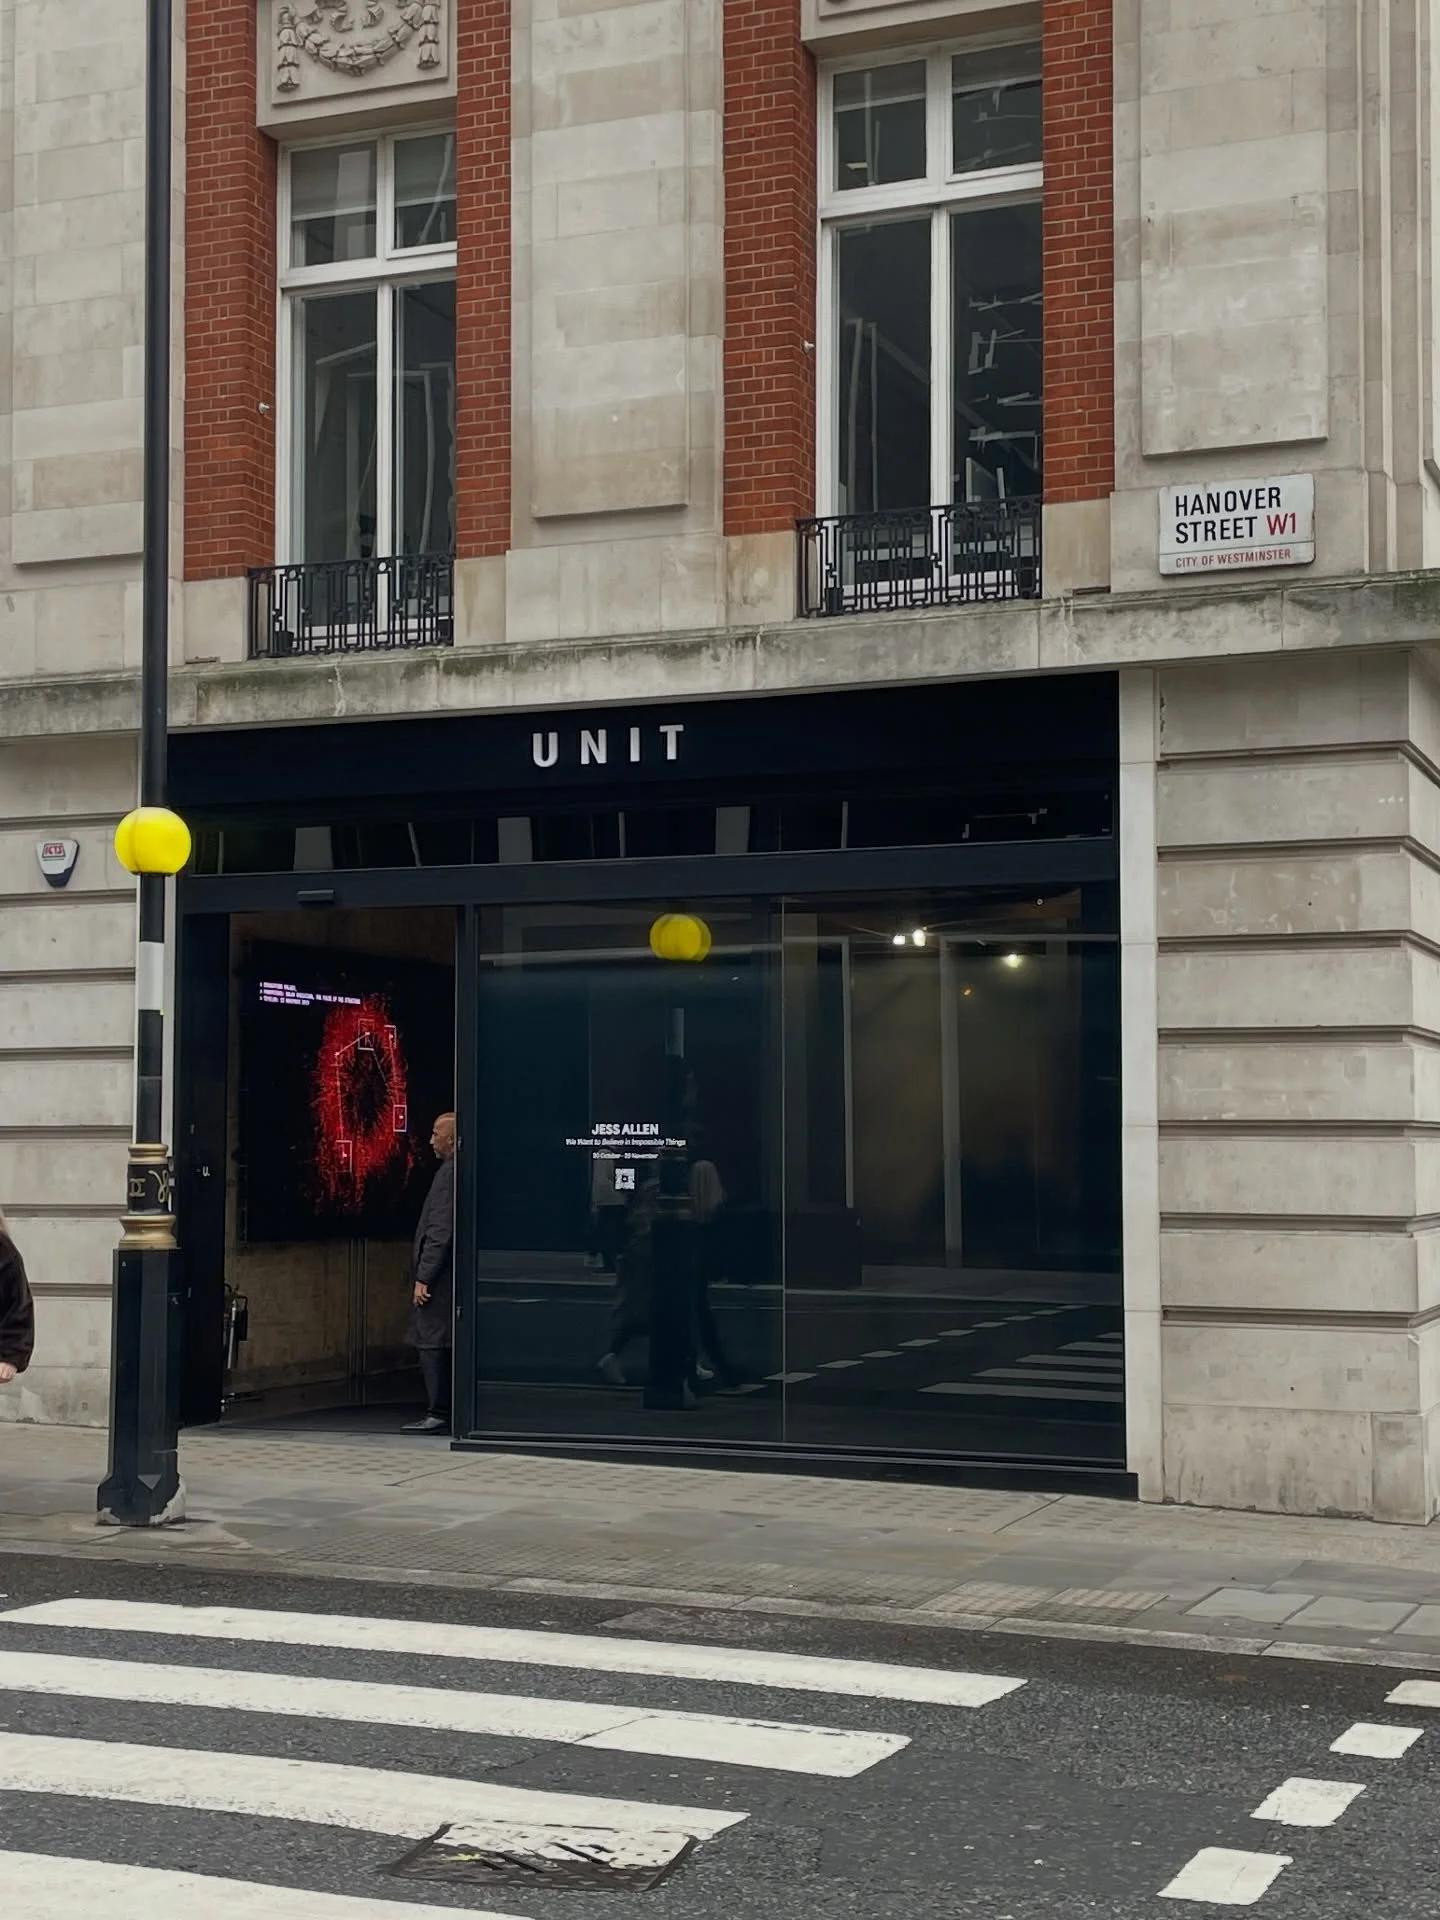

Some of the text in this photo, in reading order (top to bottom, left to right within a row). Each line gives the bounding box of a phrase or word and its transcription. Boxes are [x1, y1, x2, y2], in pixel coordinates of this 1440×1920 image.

[1175, 486, 1281, 517] HANOVER
[1175, 512, 1297, 544] STREET W1
[1175, 548, 1291, 568] CITY OF WESTMINSTER
[532, 724, 684, 768] UNIT
[592, 1123, 659, 1135] JESS ALLEN
